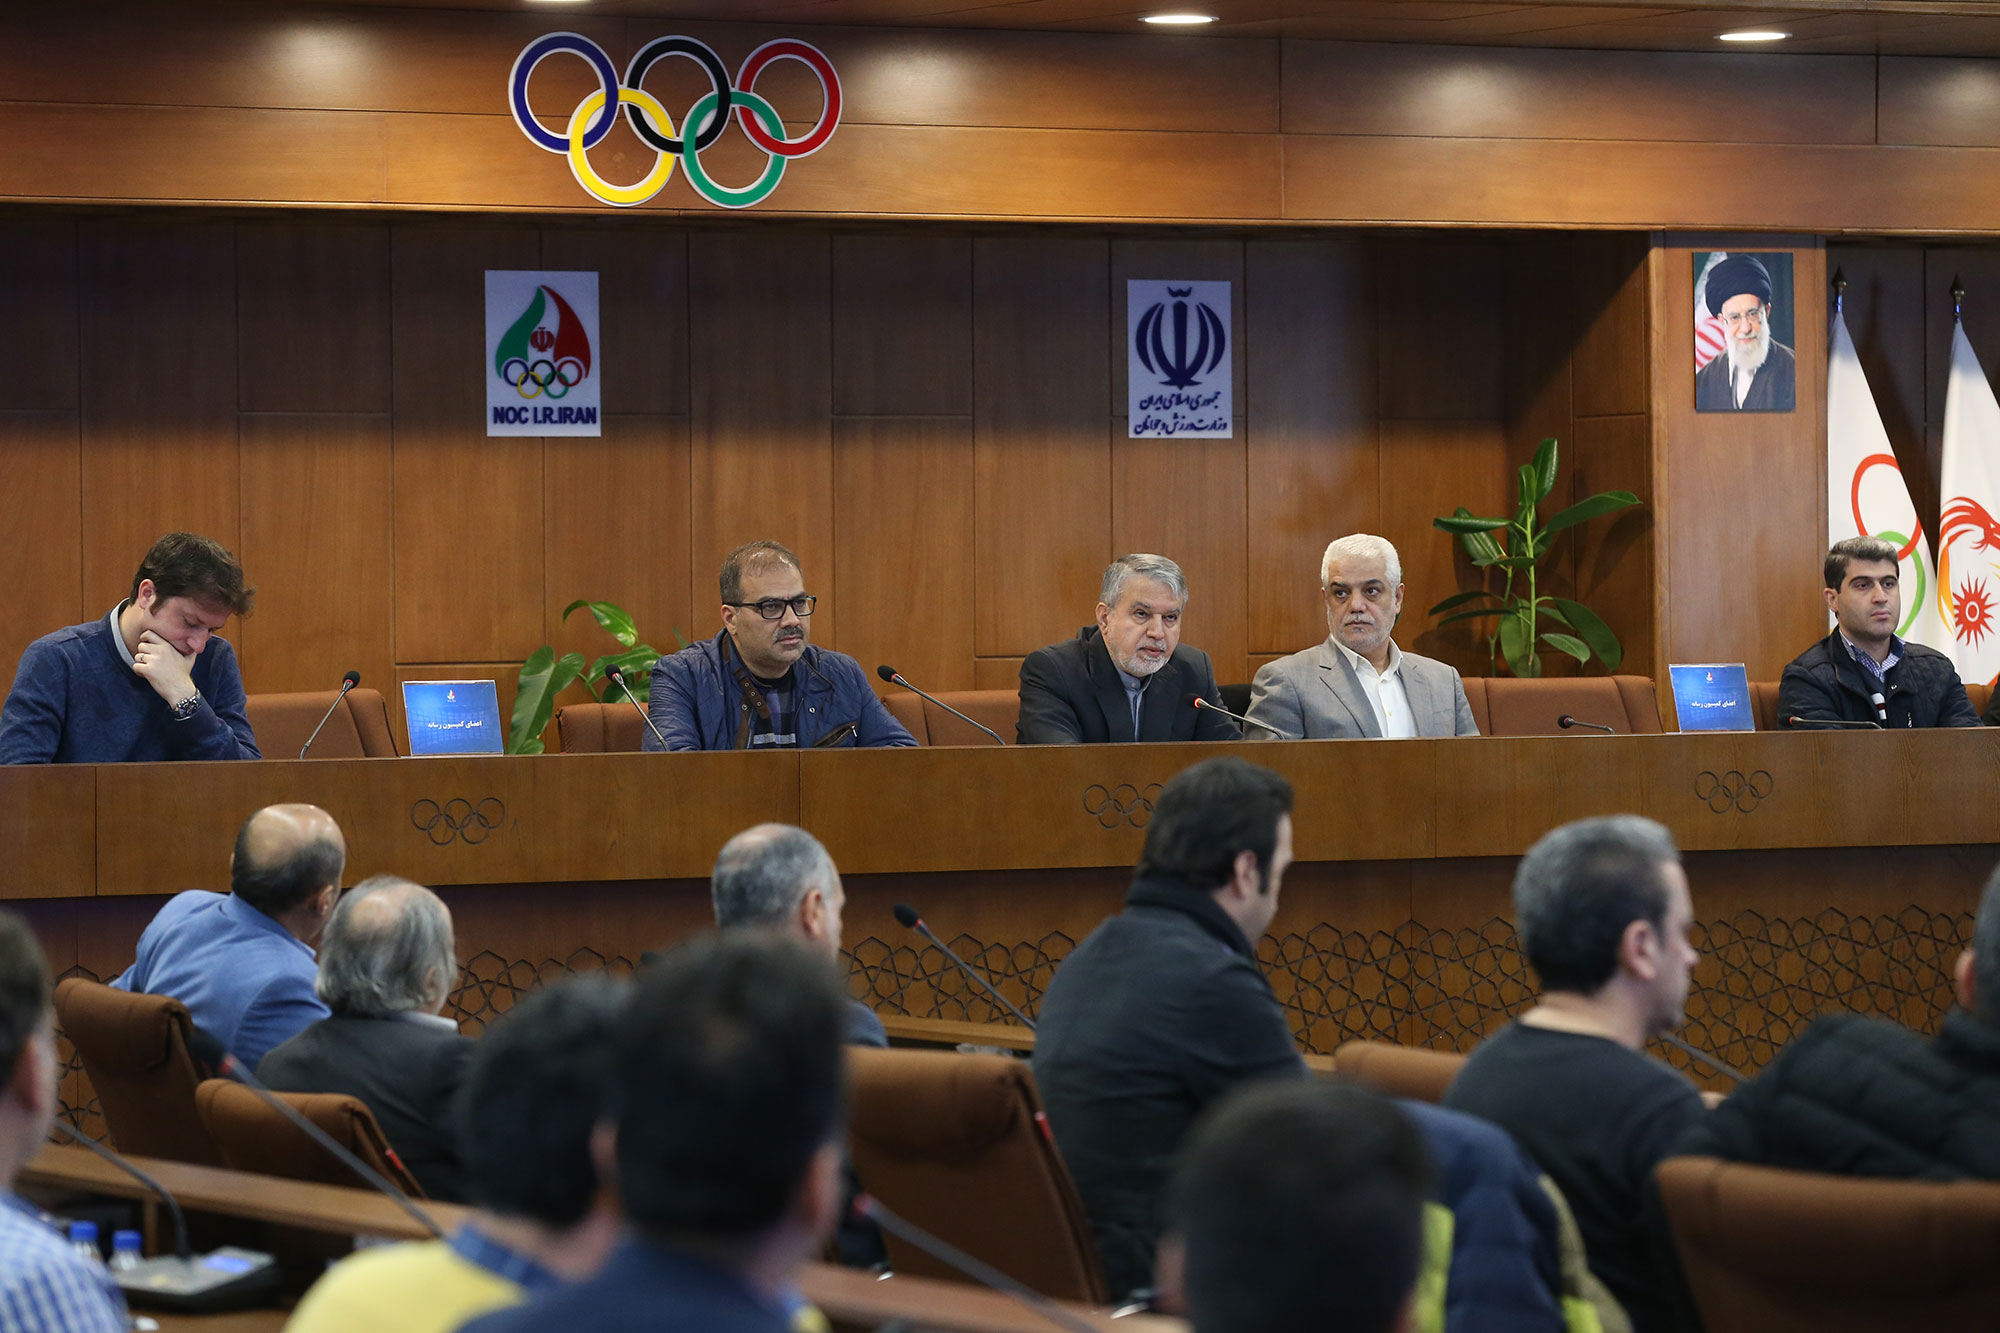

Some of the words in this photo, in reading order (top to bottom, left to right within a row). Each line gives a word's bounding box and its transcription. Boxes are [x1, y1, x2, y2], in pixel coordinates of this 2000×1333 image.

[1140, 394, 1163, 411] ایران
[1163, 393, 1189, 410] اسلامی
[1189, 391, 1221, 411] جمهوری
[493, 406, 529, 424] NOC
[533, 406, 597, 424] I.R.IRAN
[1134, 414, 1162, 435] جوانان
[1166, 412, 1195, 435] ورزش
[1195, 417, 1228, 431] وزارت
[1704, 700, 1722, 708] کمیسیون
[1722, 700, 1736, 708] اعضای
[427, 721, 442, 730] رسانه
[443, 721, 464, 730] کمیسیون
[465, 720, 482, 729] اعضای
